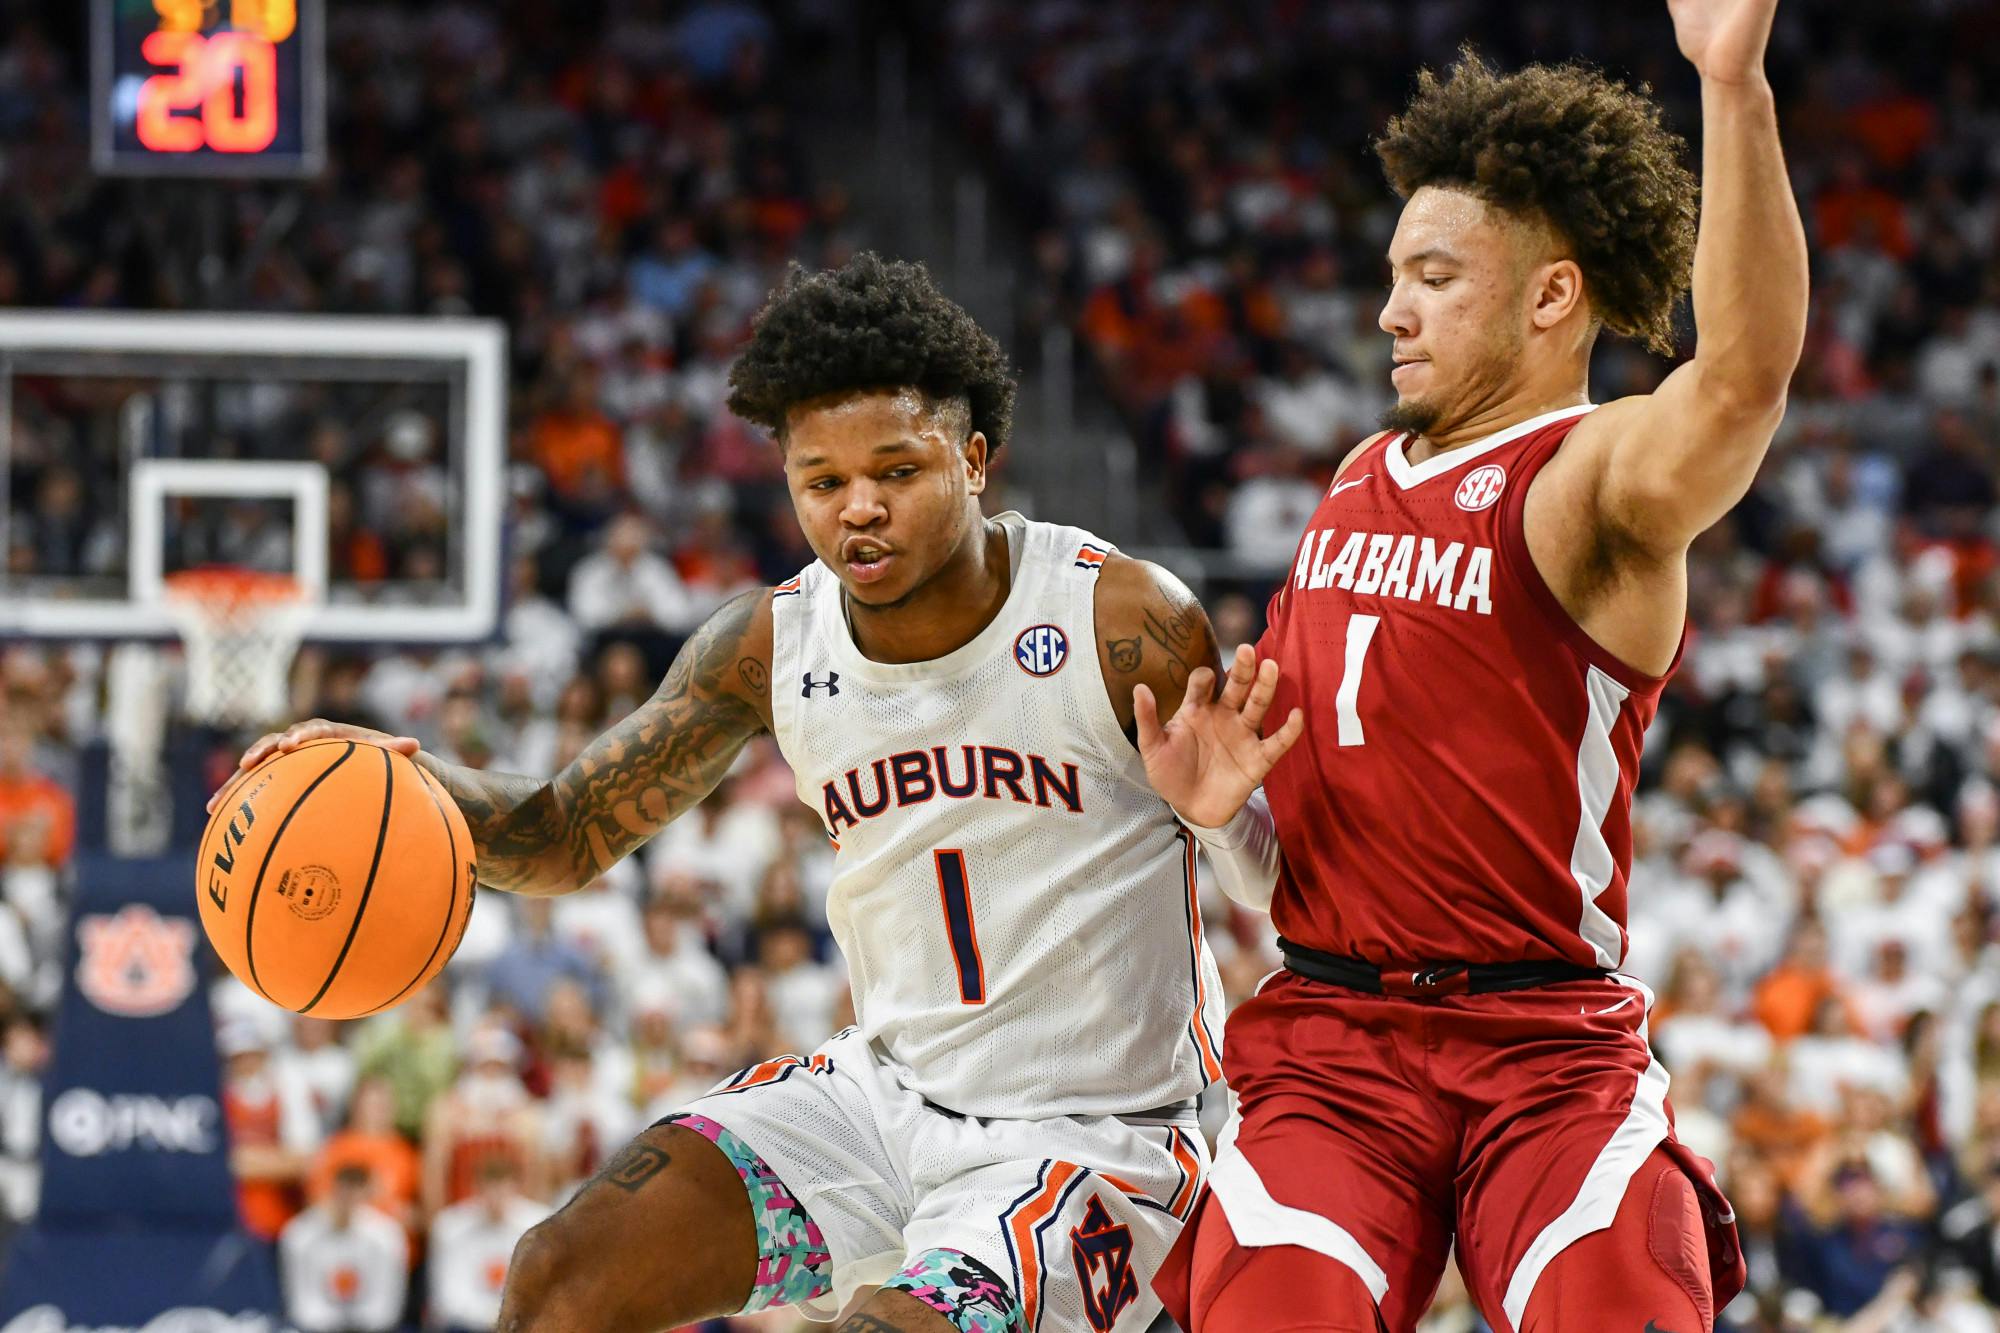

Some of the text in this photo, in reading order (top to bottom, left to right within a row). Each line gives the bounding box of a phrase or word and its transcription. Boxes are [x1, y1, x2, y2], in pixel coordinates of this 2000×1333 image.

[137, 31, 277, 153] 20
[1458, 468, 1503, 507] SEC
[1293, 529, 1493, 615] ALABAMA
[1018, 628, 1065, 673] SEC
[1336, 614, 1380, 746] 1
[822, 745, 1084, 836] AUBURN
[933, 848, 986, 1004] 1
